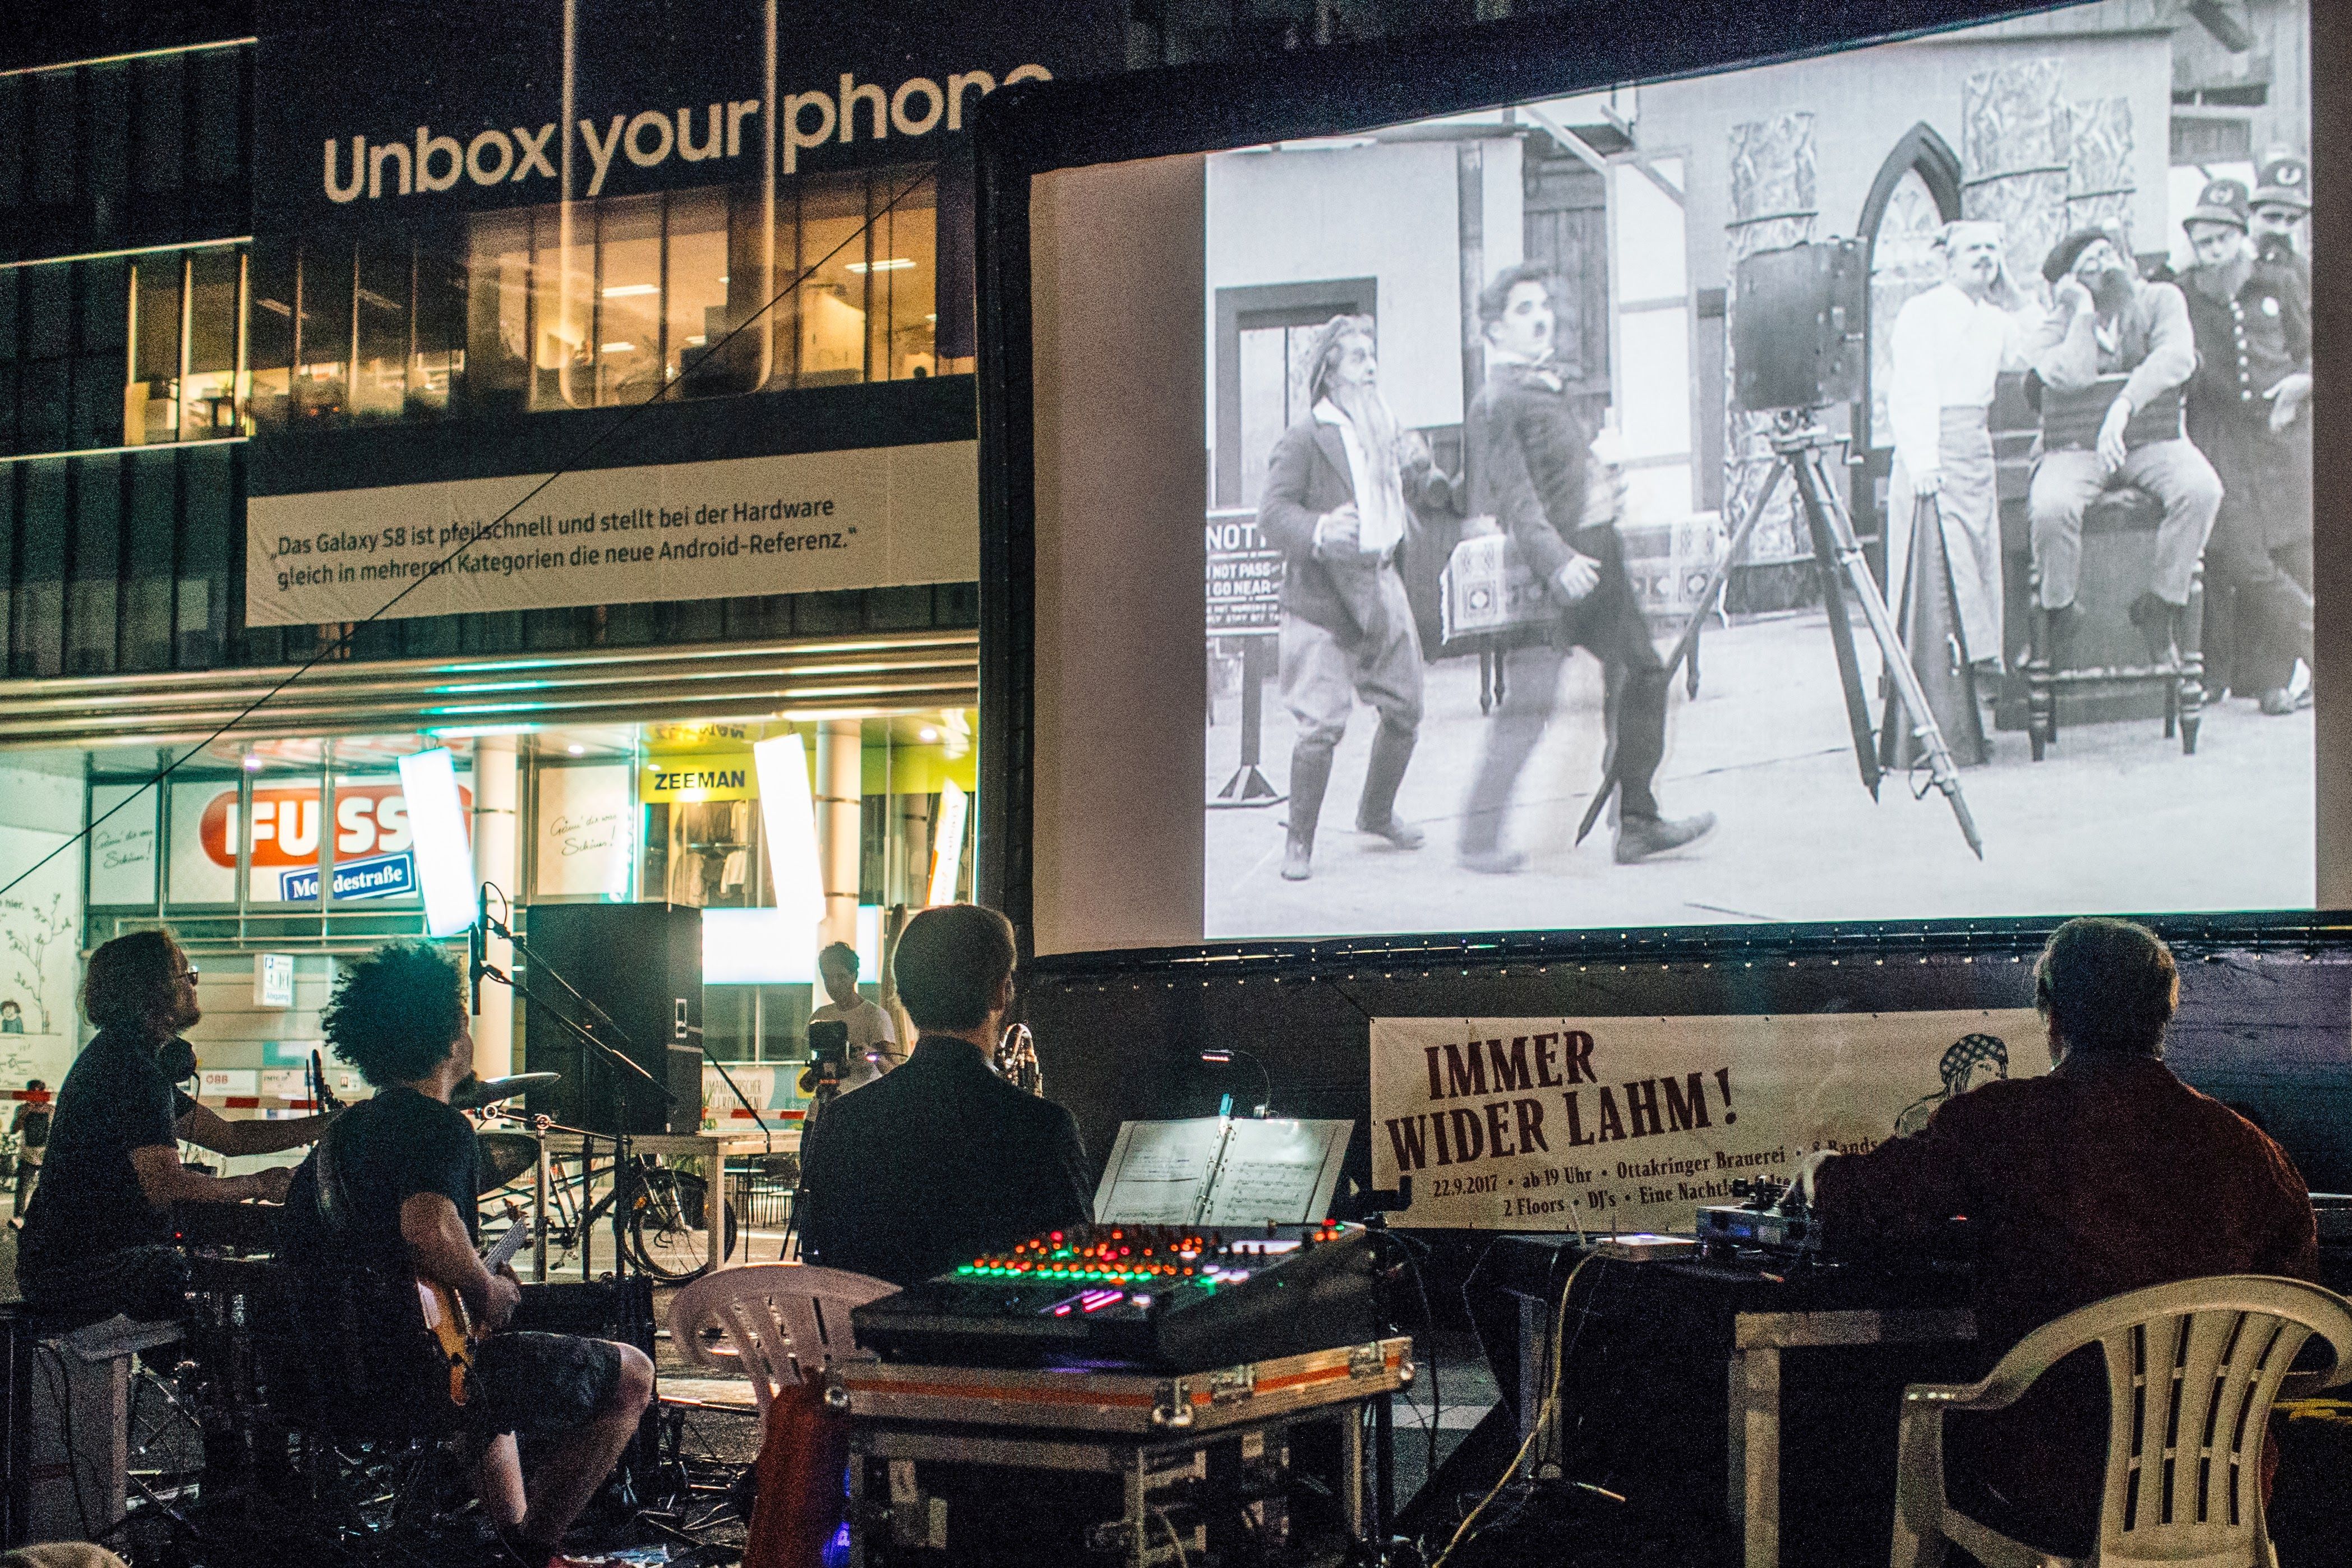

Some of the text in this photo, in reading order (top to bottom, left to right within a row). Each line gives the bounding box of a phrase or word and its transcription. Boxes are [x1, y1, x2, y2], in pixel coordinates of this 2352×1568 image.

[325, 63, 1053, 204] Unbox your phon
[316, 531, 378, 554] Galaxy
[383, 527, 405, 548] S8
[411, 525, 434, 546] ist
[440, 515, 552, 548] pfeilschnell
[559, 512, 595, 534] und
[600, 508, 653, 532] stellt
[660, 506, 690, 528] bei
[695, 504, 727, 525] der
[733, 499, 834, 522] Hardware
[277, 564, 333, 591] gleich
[338, 562, 354, 582] in
[361, 559, 451, 580] mehreren
[458, 547, 564, 577] Kategorien
[569, 542, 599, 567] die
[605, 542, 654, 563] neue
[1212, 563, 1237, 579] NOT
[1212, 581, 1233, 597] GO
[654, 770, 745, 791] ZEEMAN
[225, 796, 414, 856] FUSS
[205, 1072, 229, 1085] ÖBB
[1424, 1029, 1598, 1100] IMMER
[1385, 1067, 1737, 1172] WIDER LAHM!
[1433, 1174, 1498, 1197] 22.9.2017
[1522, 1171, 1541, 1188] ab
[1544, 1168, 1560, 1186] 19
[1564, 1166, 1592, 1184] Uhr
[1616, 1156, 1710, 1178] Ottakringer
[1715, 1145, 1786, 1169] Brauerei
[1503, 1198, 1512, 1217] 2
[1516, 1197, 1565, 1216] Floors
[1639, 1186, 1673, 1205] Eine
[1677, 1178, 1730, 1201] Nacht!
